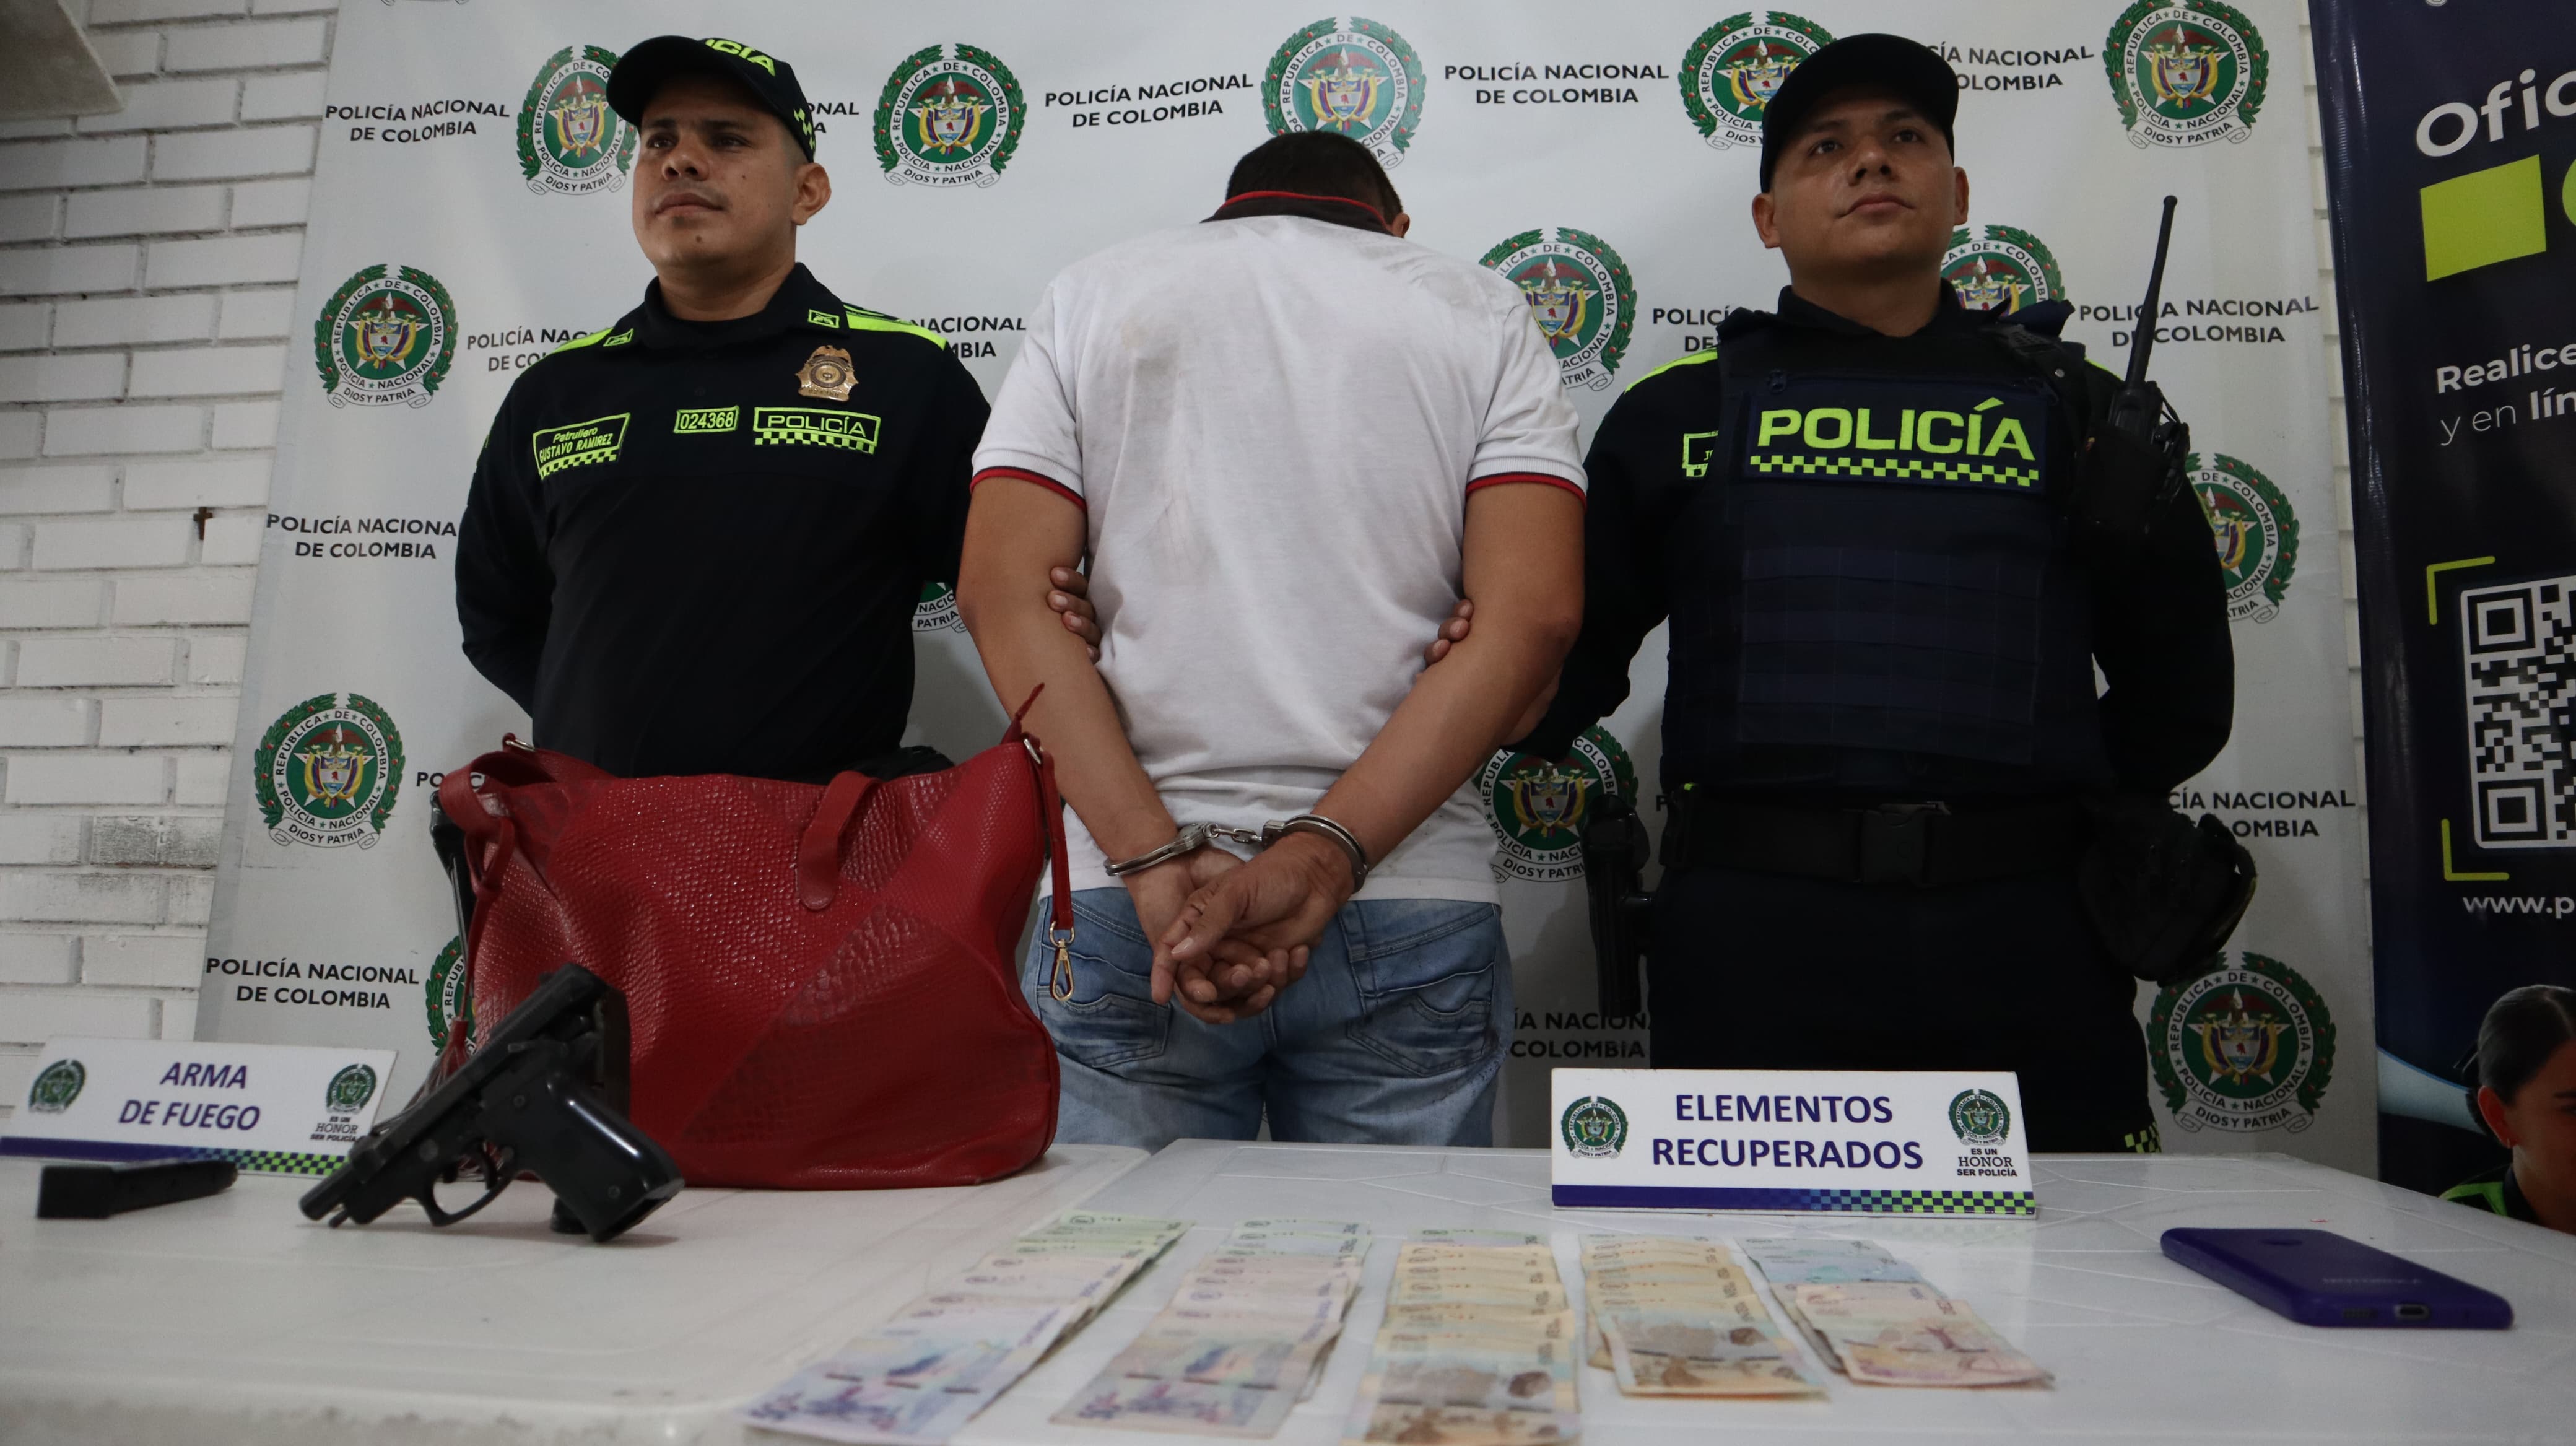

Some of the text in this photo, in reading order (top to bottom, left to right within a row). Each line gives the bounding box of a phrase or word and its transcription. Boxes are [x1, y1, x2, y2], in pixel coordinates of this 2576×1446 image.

[1754, 27, 1771, 35] DE
[2174, 9, 2188, 20] DE
[2203, 18, 2248, 74] COLOMBIA
[573, 61, 585, 71] DE
[1337, 33, 1353, 43] DE
[1367, 40, 1406, 100] COLOMBIA
[1969, 45, 2094, 66] NACIONAL
[1444, 62, 1669, 81] POLICÍA NACIONAL
[1958, 73, 2063, 91] OLOMBIA
[943, 62, 959, 71] DE
[972, 68, 1006, 127] COLOMBIA
[1045, 73, 1254, 107] POLICÍA NACIONAL
[1476, 88, 1638, 104] DE COLOMBIA
[325, 99, 510, 121] POLICÍA NACIONAL
[1072, 100, 1224, 128] DE COLOMBIA
[2187, 89, 2244, 129] NACIONAL
[350, 121, 477, 143] DE COLOMBIA
[1362, 113, 1399, 148] CIONAL
[2188, 123, 2233, 143] PATRIA
[581, 137, 622, 178] NACIONAL
[944, 139, 1000, 172] NACIONAL
[580, 172, 613, 191] PATRIA
[942, 170, 983, 184] PATRIA
[1543, 244, 1615, 316] DE COLOMBIA
[1972, 242, 2045, 300] DE COLOMBI
[385, 280, 402, 289] DE
[413, 289, 442, 346] COLOMBIA
[1653, 305, 1730, 326] POLICÍ
[2187, 297, 2320, 317] NACIONAL
[468, 326, 534, 350] POLICÍA
[1684, 335, 1714, 352] DE
[2112, 325, 2286, 347] D COLOMBIA
[1559, 331, 1609, 369] ACIONAL
[378, 359, 433, 389] NACIONAL
[488, 356, 511, 372] DE
[2437, 344, 2576, 394] Realice
[1562, 367, 1595, 385] TRIA
[375, 388, 416, 403] PATRIA
[680, 411, 734, 430] 024368
[767, 415, 867, 438] POLICÍA
[1757, 396, 2036, 461] POLICÍA
[2440, 416, 2461, 446] y
[2472, 404, 2517, 432] en
[552, 427, 598, 443] Patrullero
[539, 433, 614, 463] GUSTAVO RAMIREZ
[2201, 472, 2276, 548] DE COLOMBIA
[266, 513, 457, 537] POLICÍA NACIONA
[295, 541, 437, 559] DE COLOMBIA
[2226, 562, 2271, 600] ACIONAL
[918, 593, 956, 613] NACIO
[916, 610, 959, 628] PATRIA
[334, 710, 350, 720] DE
[360, 718, 386, 780] COLOMBIA
[1574, 738, 1616, 795] COLOMBI
[329, 794, 380, 829] NACIONAL
[2213, 790, 2356, 810] NACIONAL
[327, 827, 365, 844] PATRIA
[2232, 819, 2320, 837] OMBIA
[206, 957, 419, 985] POLICÍA NACIONAL
[236, 985, 391, 1009] DE COLOMBIA
[1545, 1012, 1648, 1030] NACION
[2228, 972, 2247, 982] DE
[2263, 980, 2311, 1052] COLOMBIA
[1510, 1040, 1645, 1058] COLOMBIA
[160, 1061, 248, 1089] ARMA
[2243, 1068, 2307, 1111] NACIONAL
[118, 1099, 261, 1130] DE FUEGO
[1676, 1094, 1894, 1123] ELEMENTOS
[2244, 1107, 2292, 1128] PATRIA
[315, 1123, 359, 1134] HONOR
[1652, 1138, 1923, 1169] RECUPERADOS
[1958, 1157, 2013, 1167] HONOR
[1978, 1168, 2017, 1177] POLICÍA
